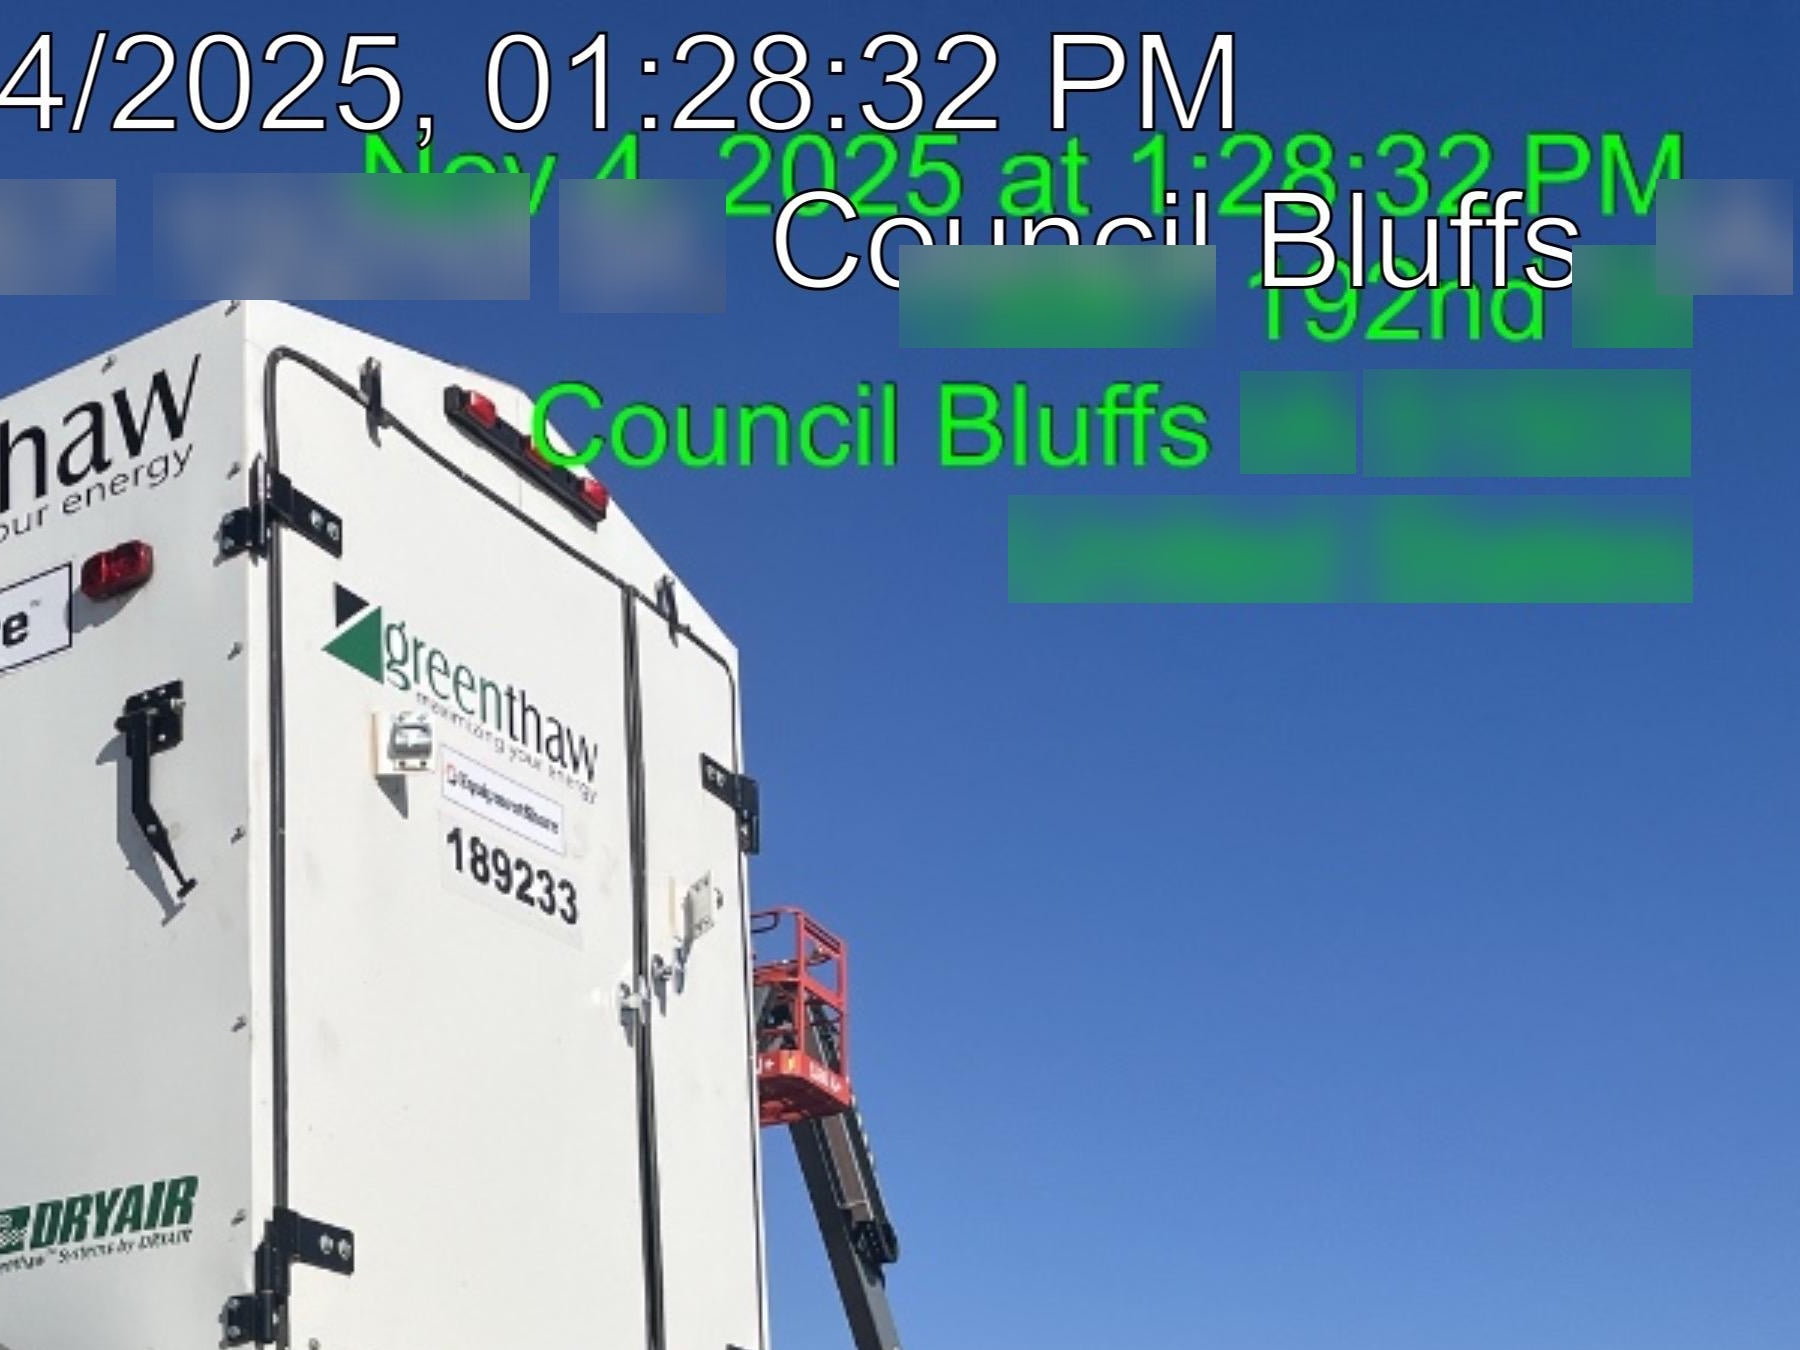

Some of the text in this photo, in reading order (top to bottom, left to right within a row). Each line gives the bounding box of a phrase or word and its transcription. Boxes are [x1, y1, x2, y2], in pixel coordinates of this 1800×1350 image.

[61, 443, 194, 513] energy
[384, 620, 599, 783] greenthaw
[446, 826, 579, 925] 189233
[29, 1174, 199, 1249] DRYAIR
